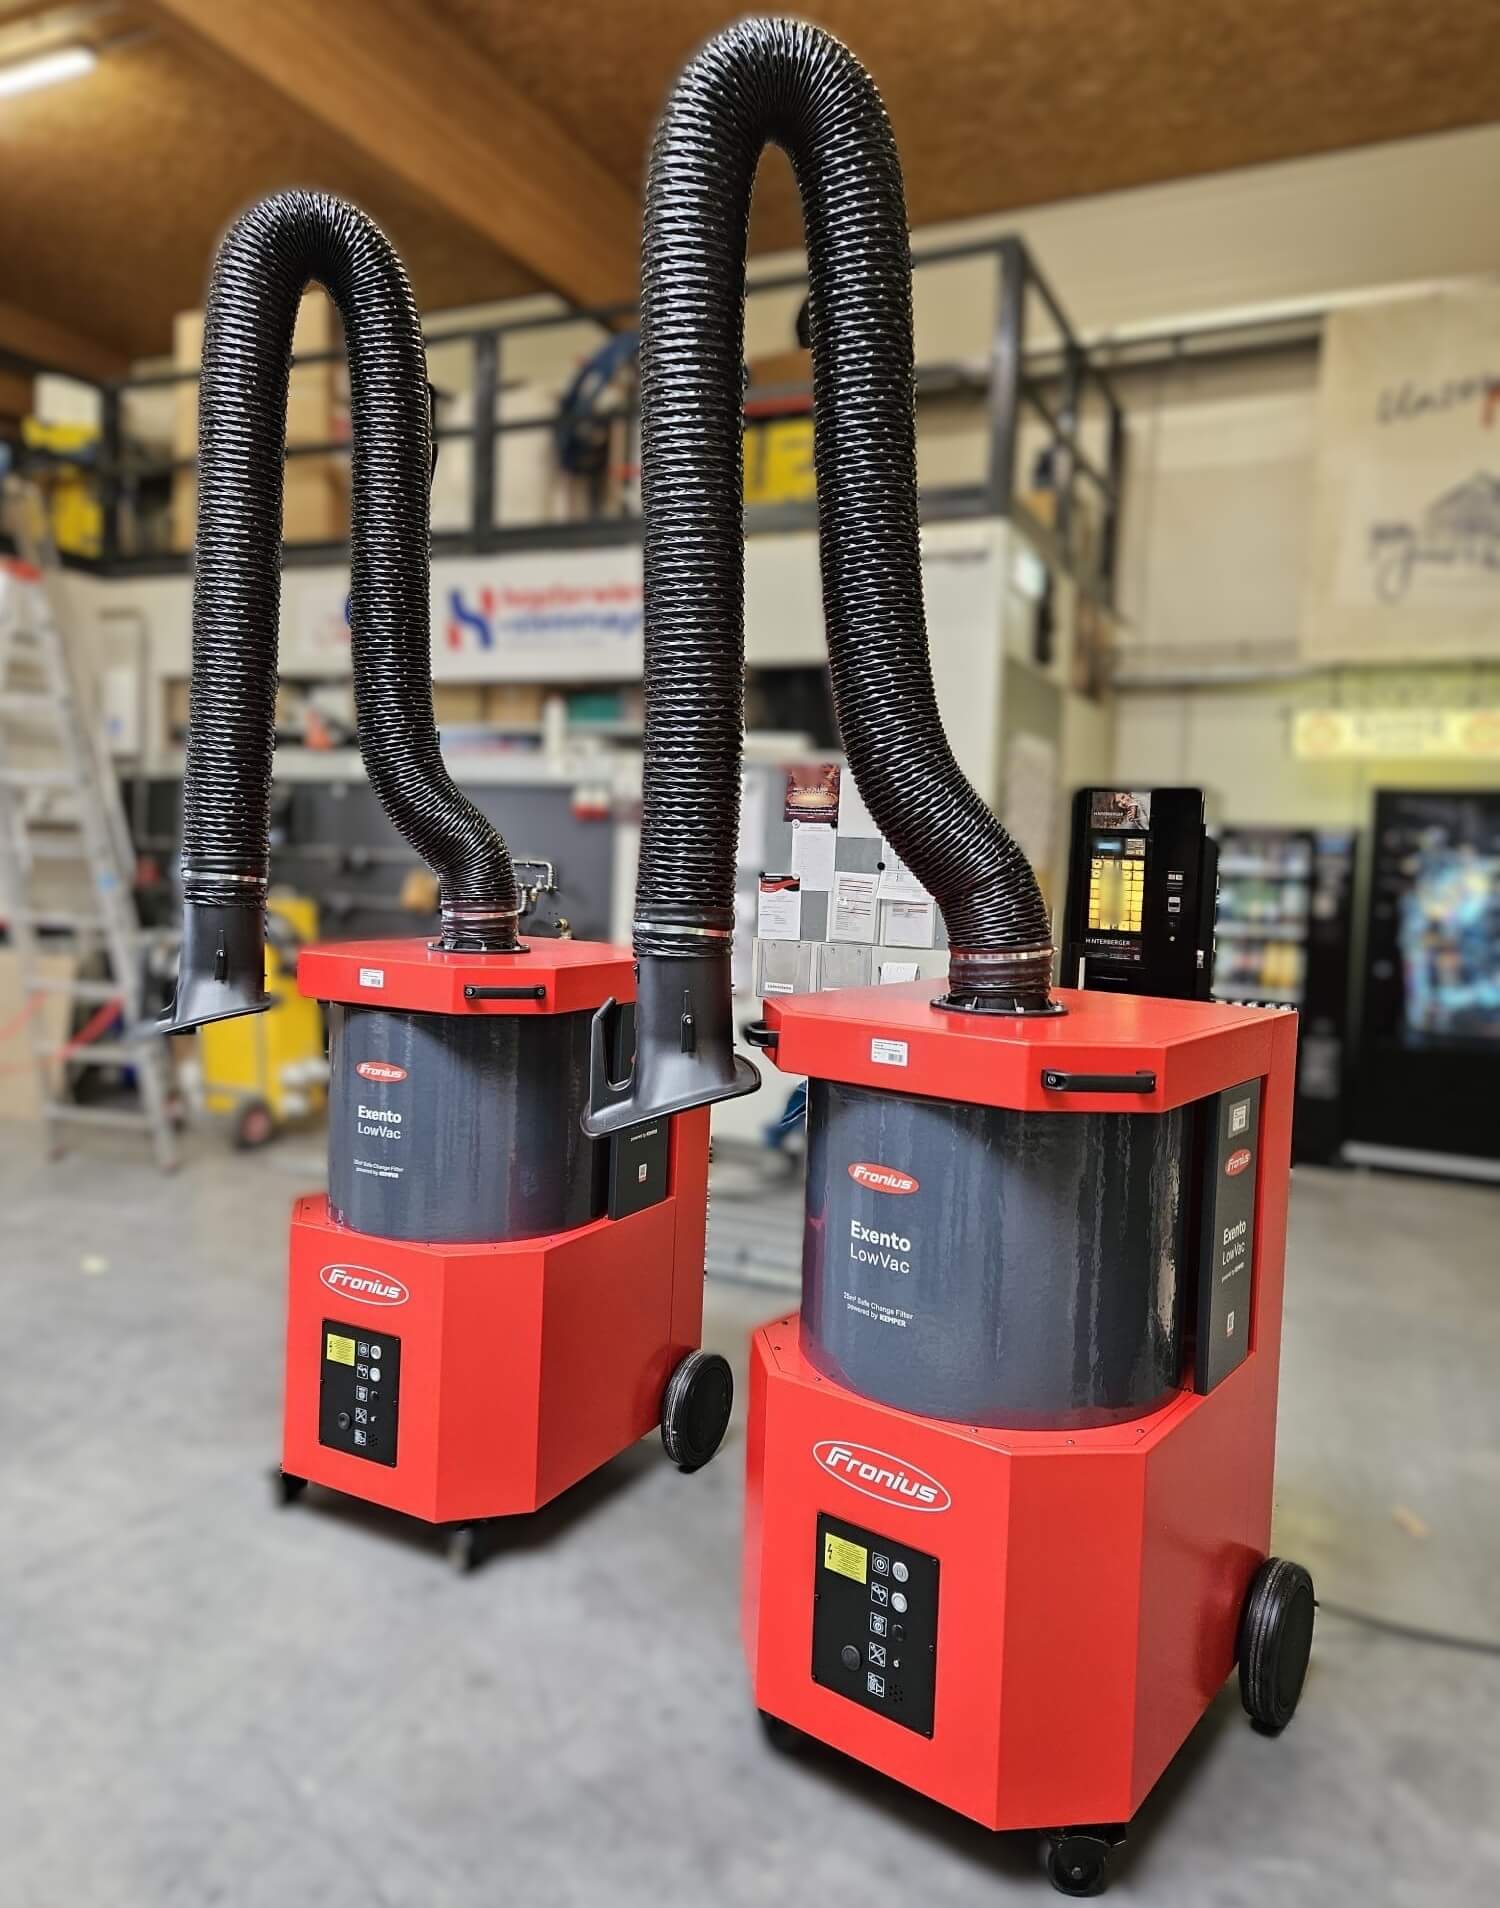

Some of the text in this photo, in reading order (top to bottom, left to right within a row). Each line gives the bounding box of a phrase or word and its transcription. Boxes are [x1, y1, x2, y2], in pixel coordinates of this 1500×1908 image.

[1085, 938, 1131, 946] HNTERBERGER
[360, 1063, 403, 1078] Fronius
[358, 1104, 402, 1123] Exento
[358, 1121, 401, 1140] LowVac
[853, 1165, 913, 1190] Fronius
[850, 1219, 911, 1252] Exento
[1223, 1219, 1246, 1246] Exento
[850, 1242, 910, 1274] LowVac
[328, 1268, 401, 1299] Fronius
[847, 1303, 906, 1328] powered by KEMPER
[870, 1302, 895, 1315] Change
[895, 1309, 914, 1320] Filter
[826, 1446, 938, 1503] Fronius
